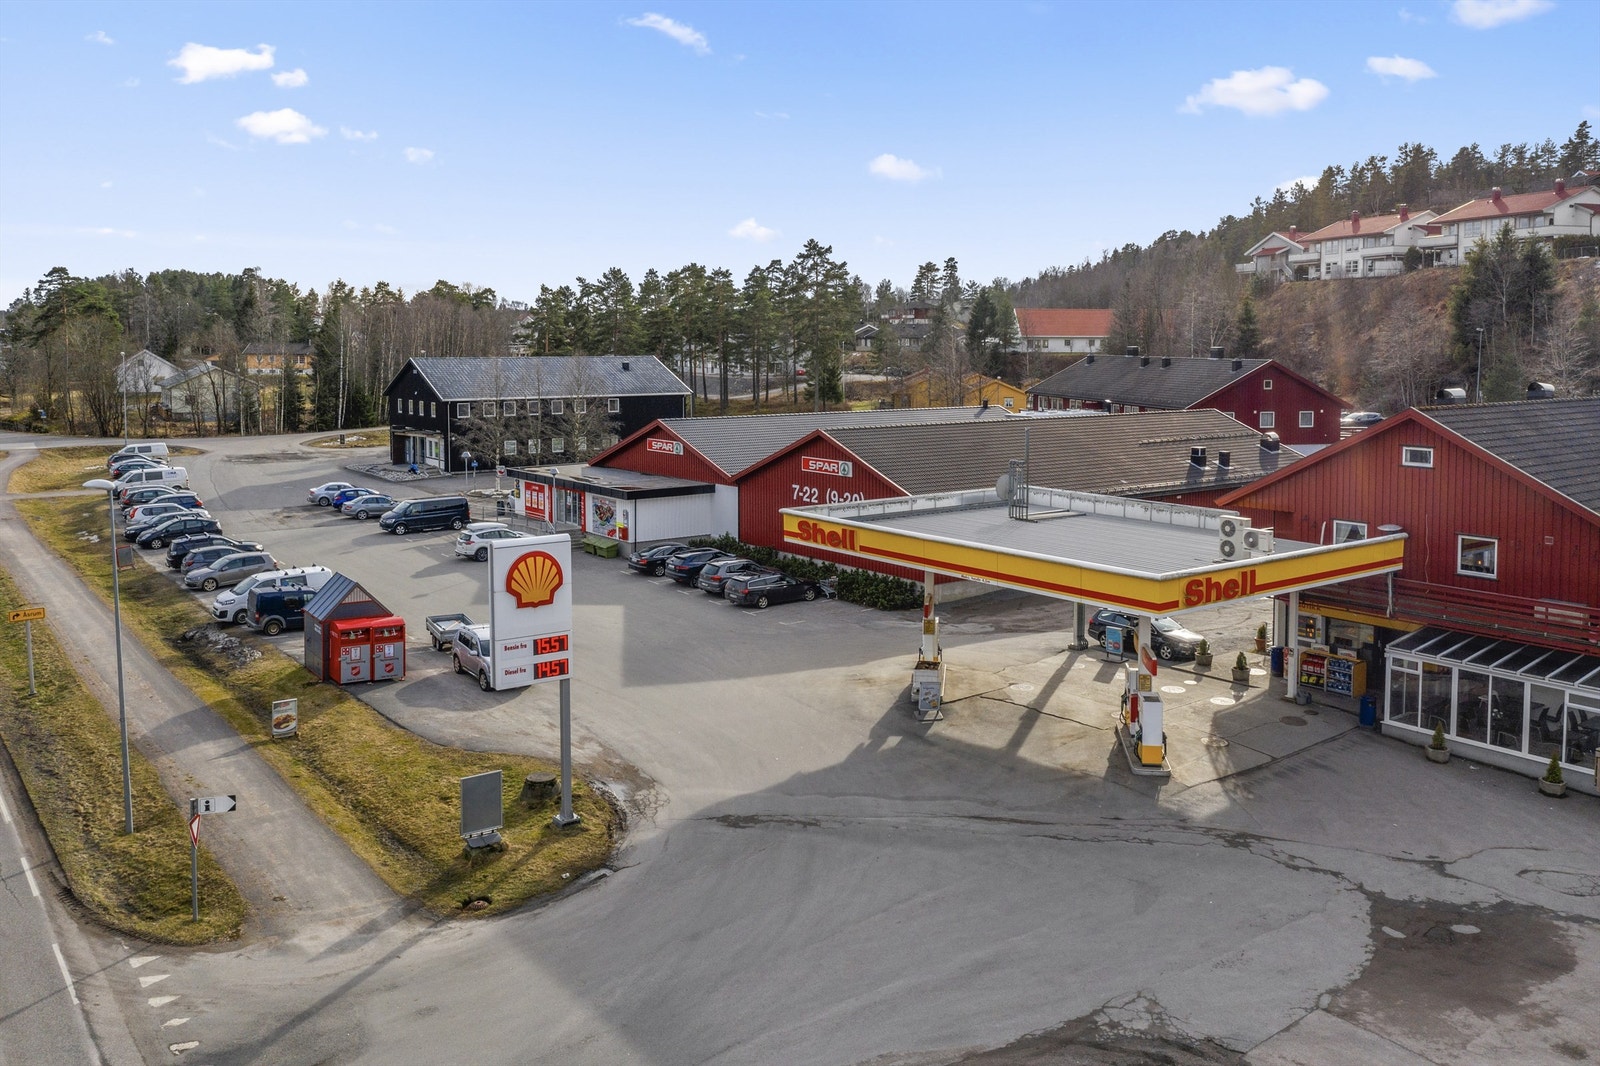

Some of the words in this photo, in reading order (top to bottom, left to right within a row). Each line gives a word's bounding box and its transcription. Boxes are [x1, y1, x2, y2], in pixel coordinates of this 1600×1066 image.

[651, 441, 673, 452] SPAR
[808, 460, 838, 473] SPAR
[792, 484, 818, 503] 7-22
[797, 520, 856, 551] Shell
[1184, 569, 1257, 607] Shell
[504, 643, 519, 651] Bensin
[536, 635, 568, 655] 15.57
[504, 668, 519, 676] Diesel
